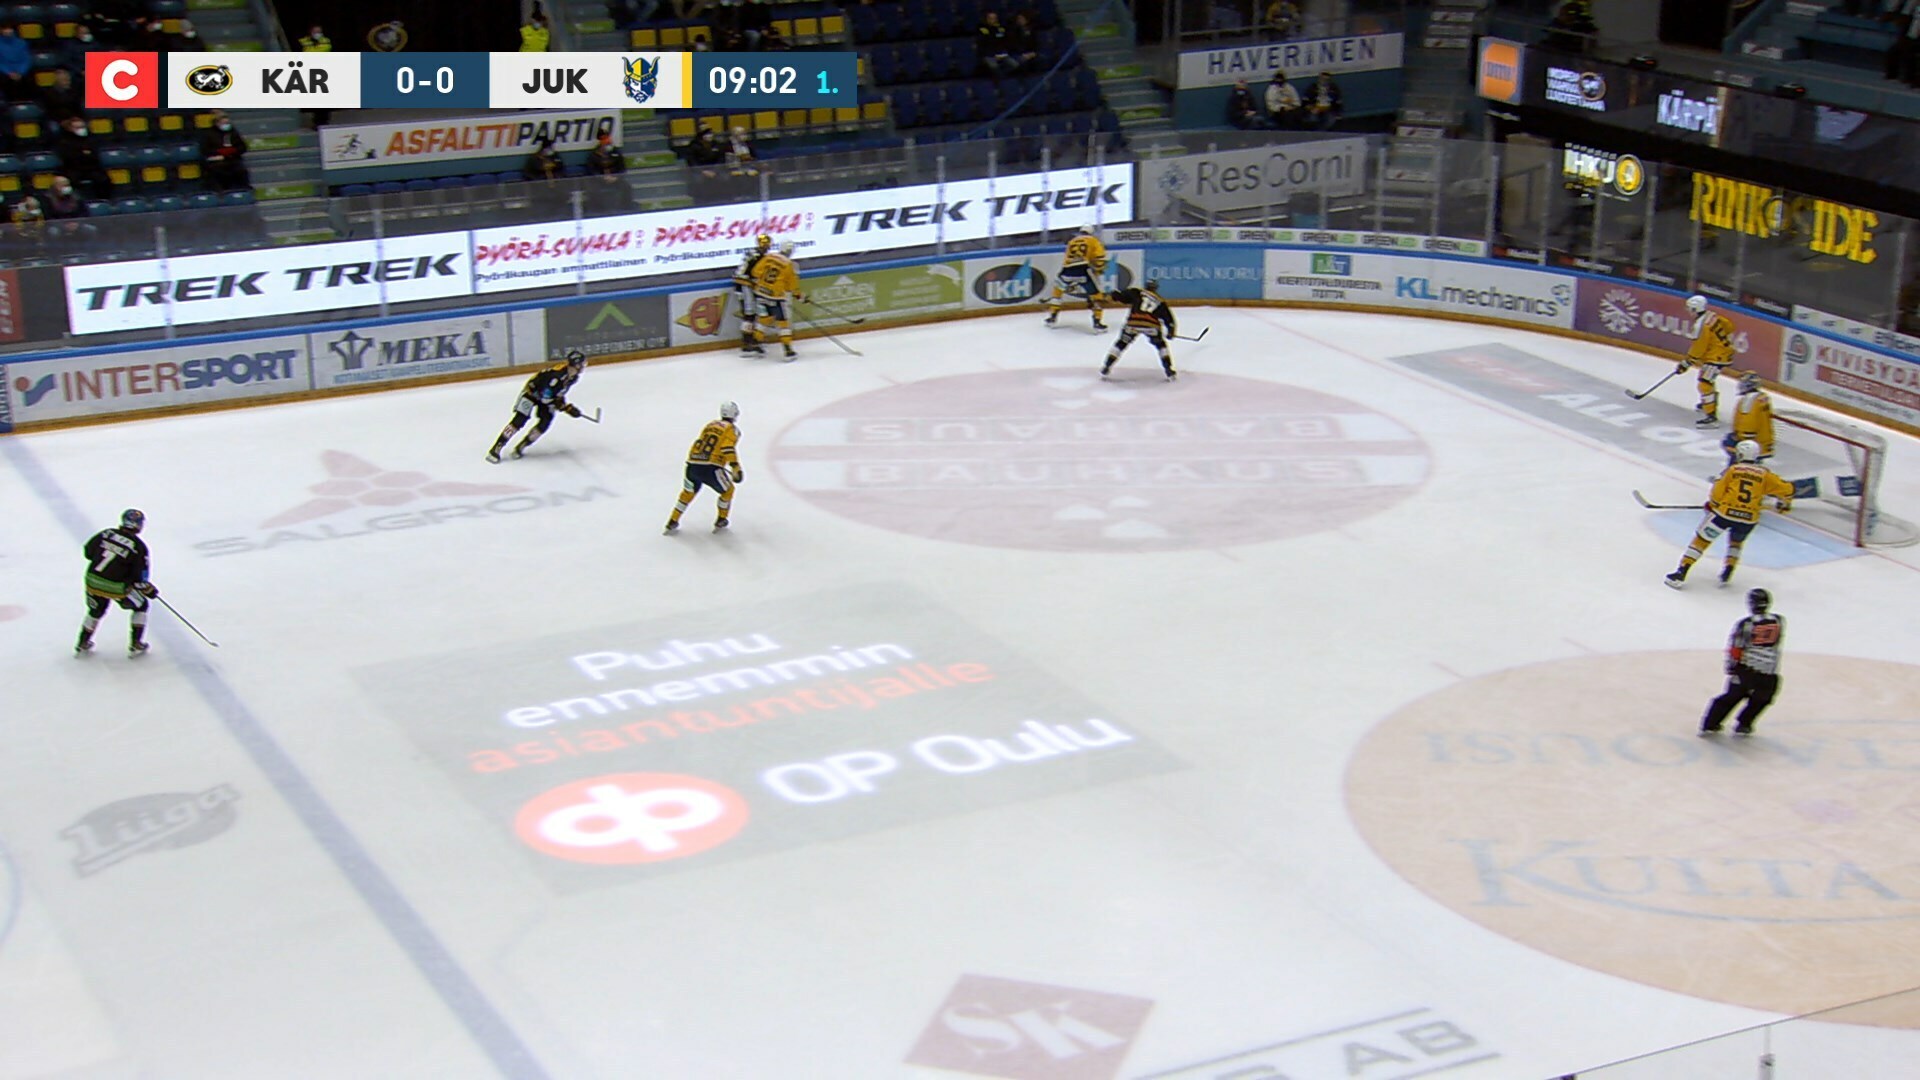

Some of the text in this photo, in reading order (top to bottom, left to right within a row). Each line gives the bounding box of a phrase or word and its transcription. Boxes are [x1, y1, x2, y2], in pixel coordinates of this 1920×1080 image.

[1195, 145, 1354, 196] ResCorni
[825, 198, 965, 235] TREK
[984, 182, 1126, 217] TREK
[76, 252, 463, 311] TREK TREK
[985, 278, 1032, 301] IKH
[1396, 275, 1559, 318] KL mechanics
[61, 349, 298, 402] INTERSPORT
[376, 331, 487, 367] MEKA
[860, 419, 1329, 444] BAUHAUS
[858, 457, 1347, 484] BAUHAUS
[1738, 479, 1753, 503] 5
[193, 485, 620, 556] SALGROM
[570, 630, 781, 682] Puhu
[504, 639, 914, 729] ennemmin
[467, 657, 993, 774] asiantuntijalle
[760, 716, 1134, 805] OP Oulu
[60, 785, 238, 872] Liiga
[1340, 1019, 1479, 1077] AB
